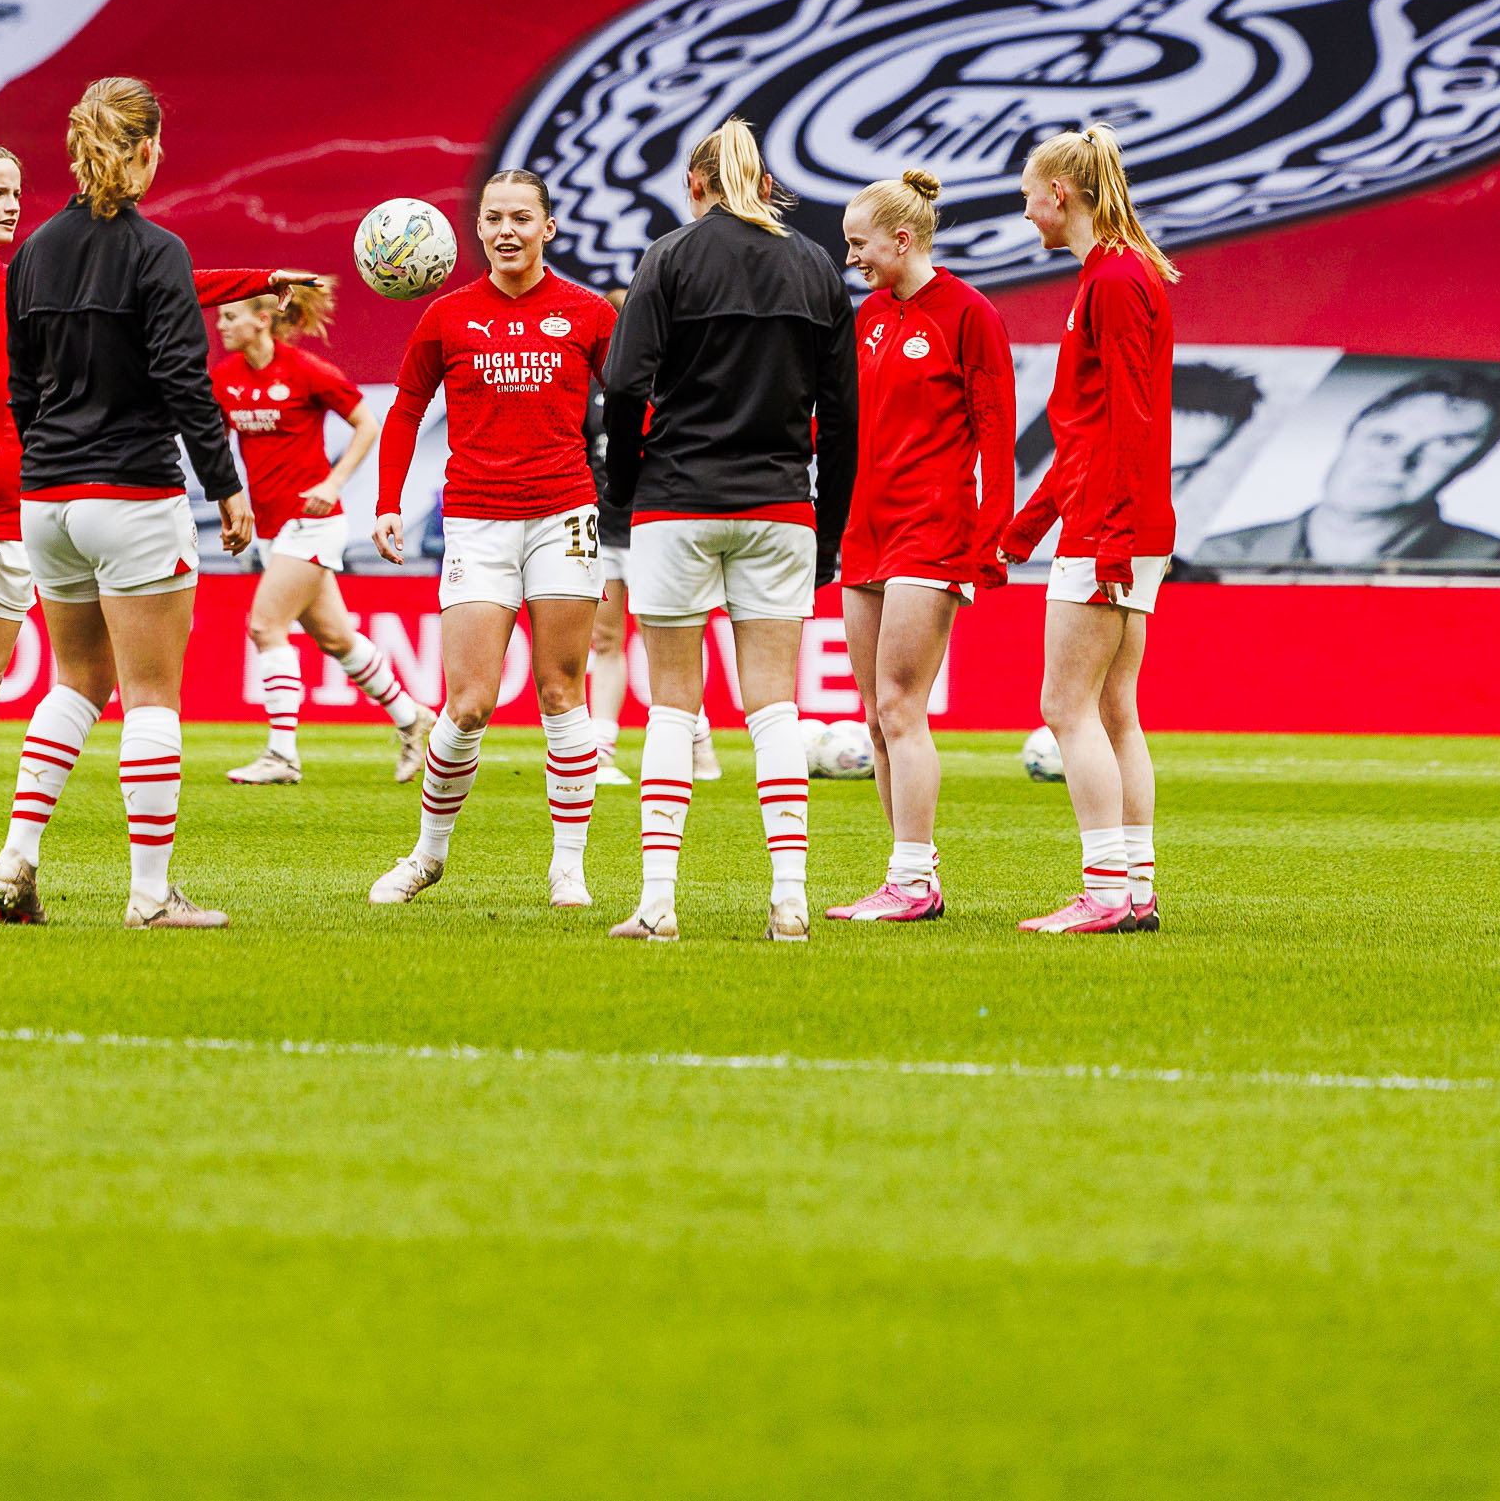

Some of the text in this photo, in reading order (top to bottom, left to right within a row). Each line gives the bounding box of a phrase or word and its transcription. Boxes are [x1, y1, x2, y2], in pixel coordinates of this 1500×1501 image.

[508, 321, 525, 335] 19
[474, 351, 562, 369] HIGH TECH
[483, 367, 554, 384] CAMPUS
[496, 384, 541, 393] EINDHOVEN
[564, 513, 599, 559] 19
